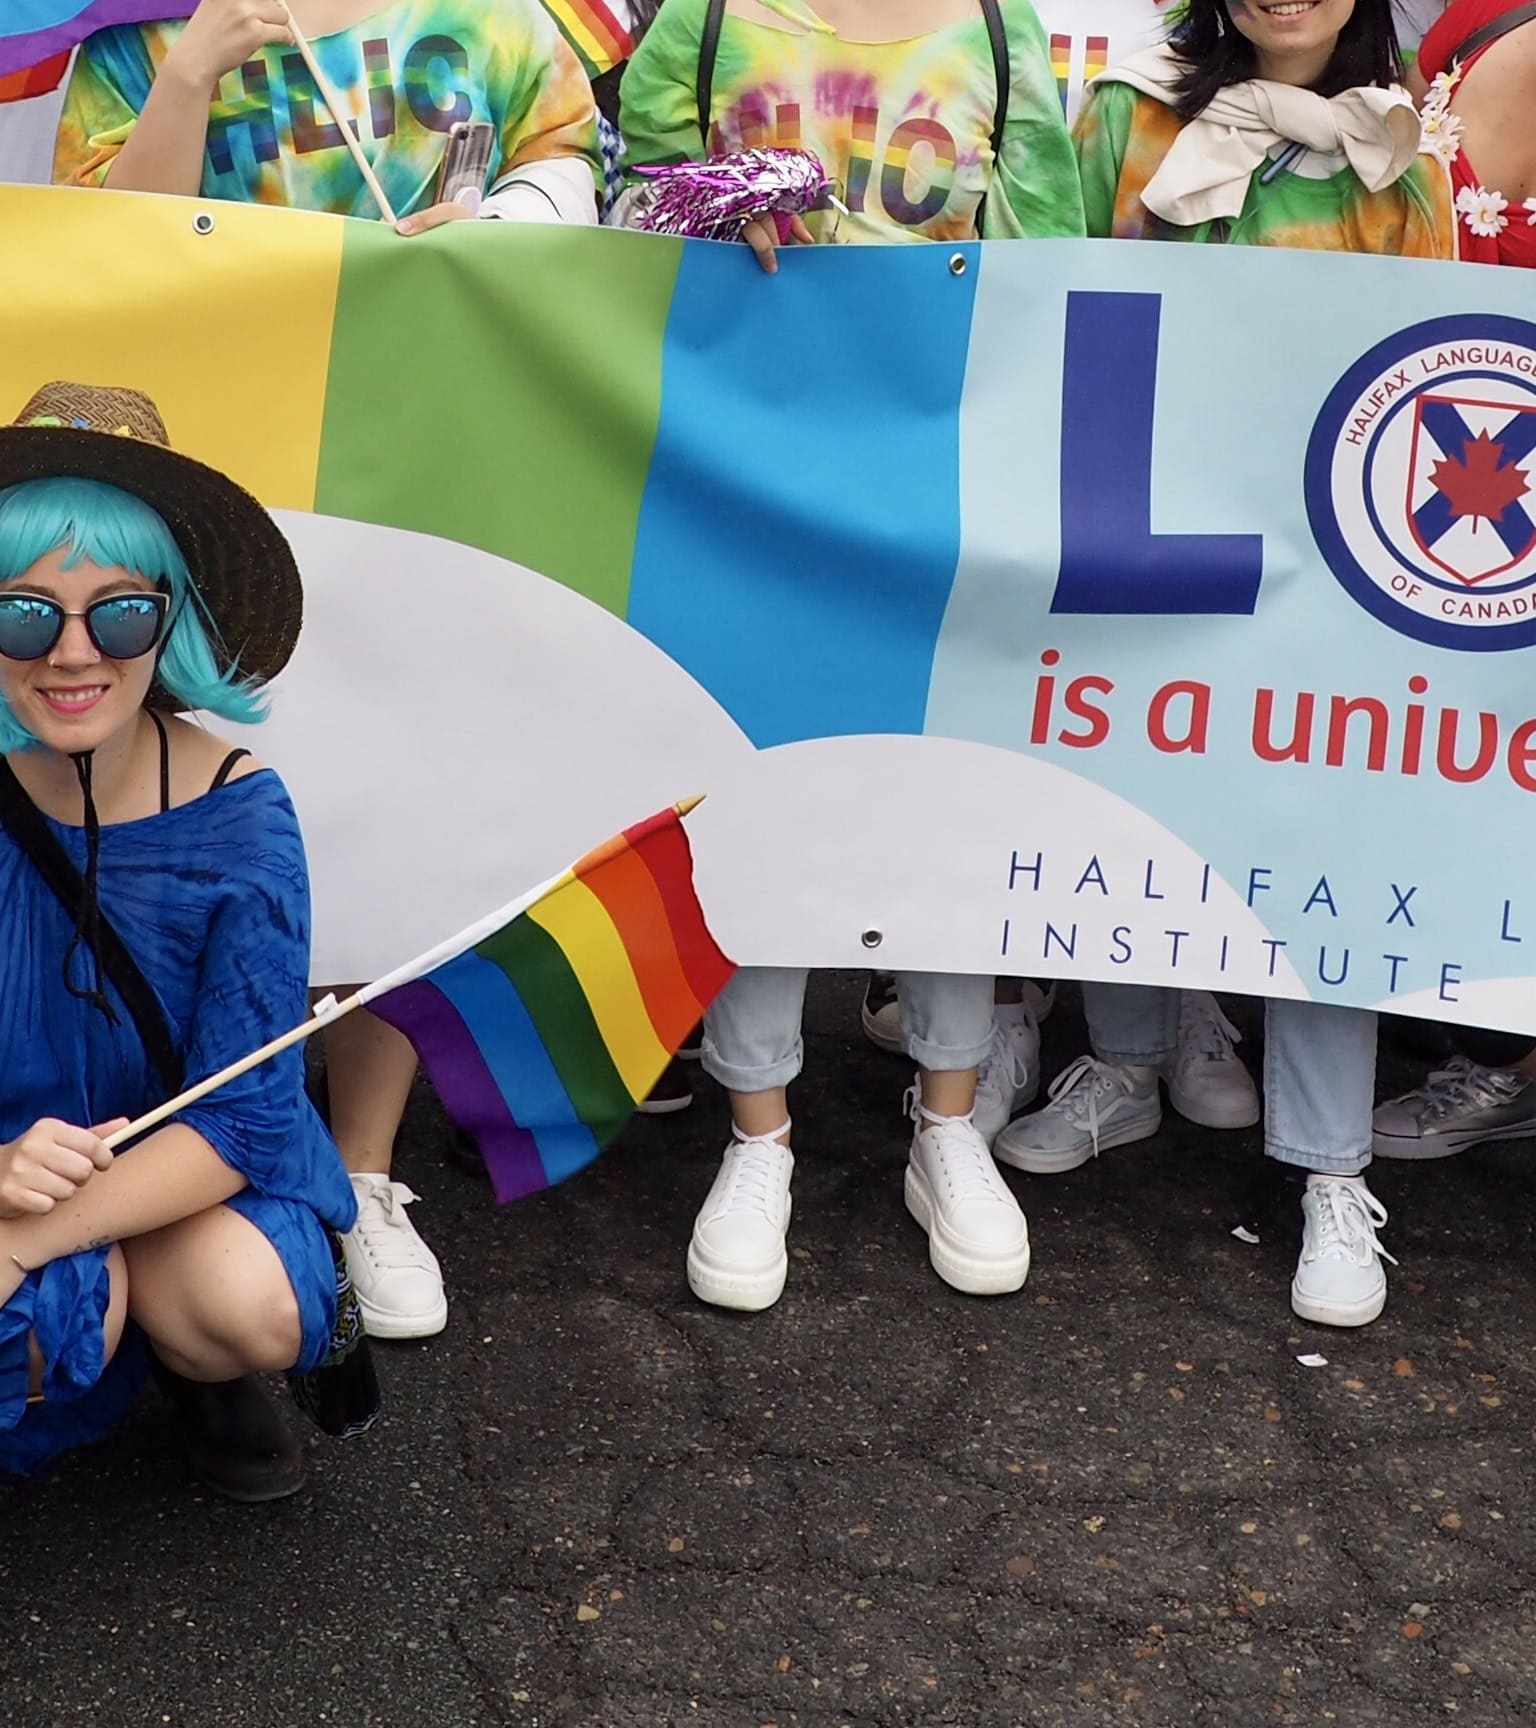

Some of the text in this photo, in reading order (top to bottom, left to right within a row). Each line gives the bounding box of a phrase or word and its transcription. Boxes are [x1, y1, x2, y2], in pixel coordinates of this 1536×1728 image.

[207, 34, 473, 177] HLIC
[1345, 368, 1412, 446] HALIFAX
[1390, 574, 1423, 600] OF
[1029, 648, 1115, 749] is
[1145, 679, 1212, 755] a
[1007, 850, 1418, 928] HALIFAX
[1000, 918, 1463, 1003] INSTITUTE
